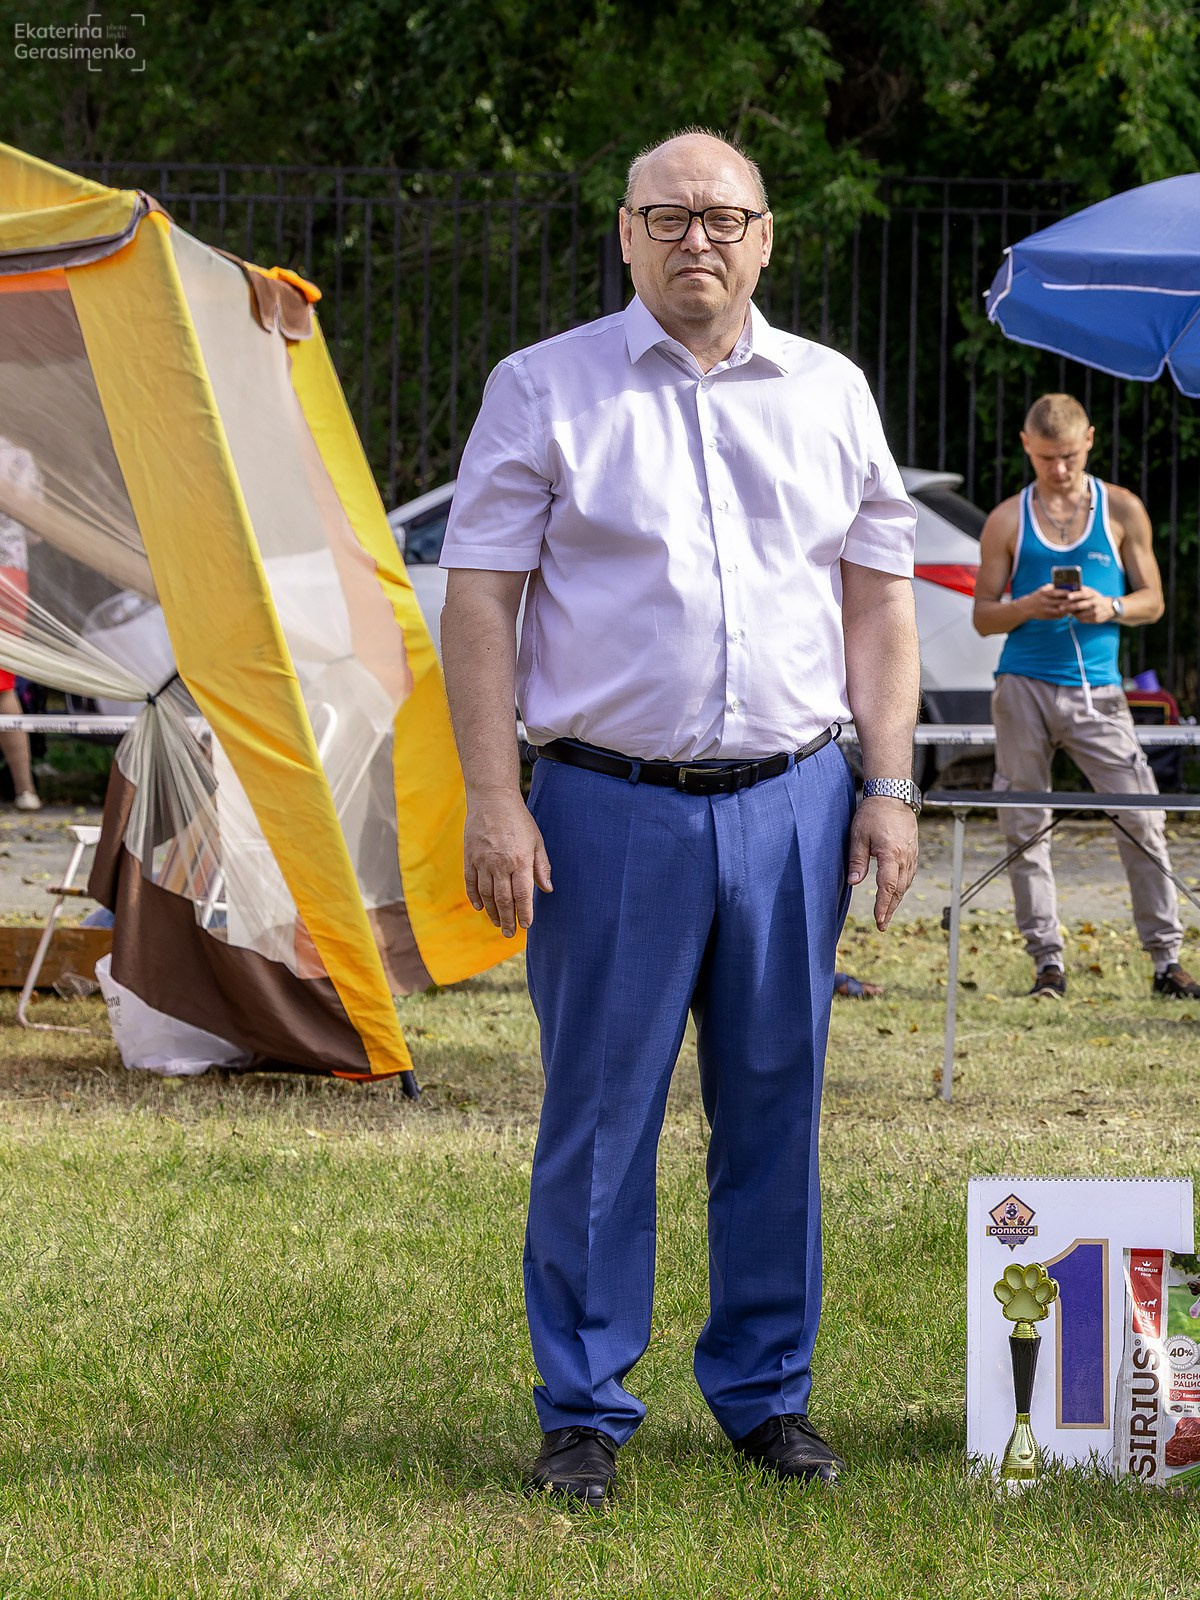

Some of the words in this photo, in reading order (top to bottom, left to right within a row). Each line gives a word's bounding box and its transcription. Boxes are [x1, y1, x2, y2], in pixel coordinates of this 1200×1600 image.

[1044, 1238, 1110, 1430] 1
[1169, 1347, 1193, 1358] 40%
[1129, 1347, 1160, 1479] SIRIUS
